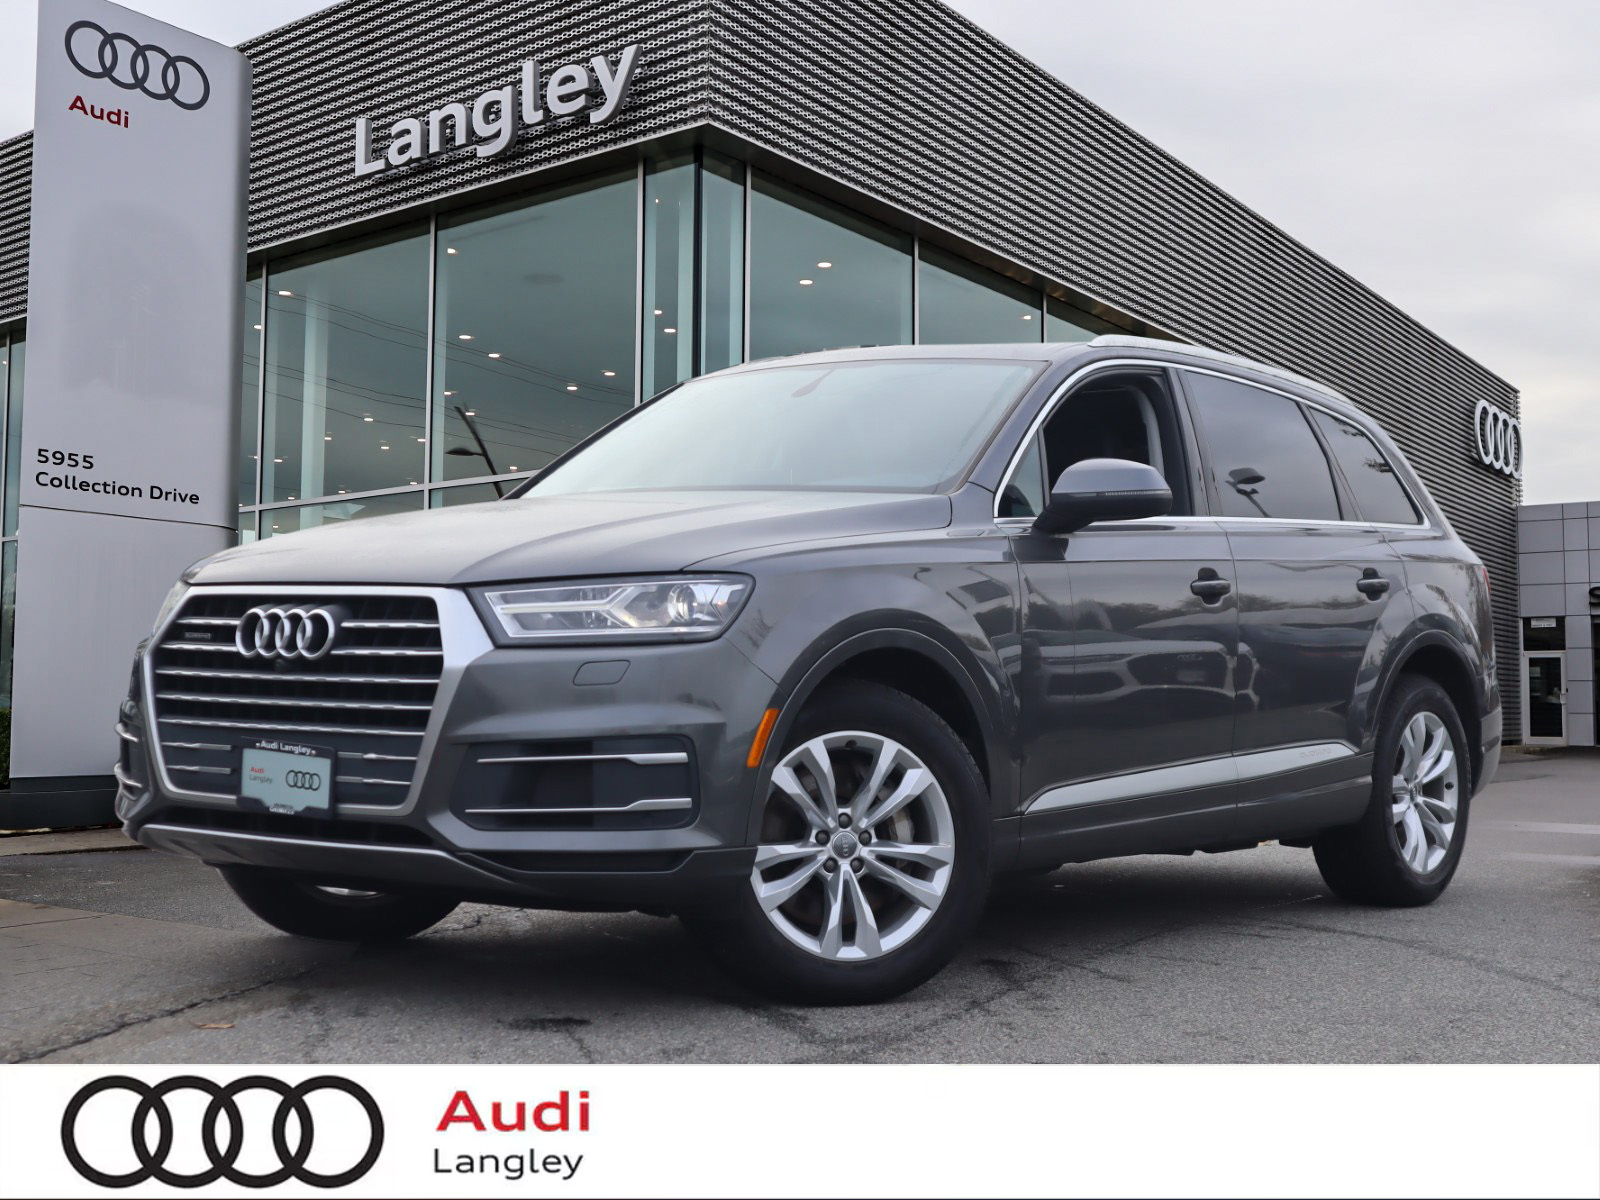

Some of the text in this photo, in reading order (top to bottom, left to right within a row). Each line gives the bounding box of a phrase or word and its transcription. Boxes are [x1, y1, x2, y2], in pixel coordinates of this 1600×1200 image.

[69, 95, 129, 128] Audi
[355, 44, 643, 176] Langley
[37, 448, 94, 470] 5955
[35, 471, 200, 505] Collection Drive
[260, 740, 311, 755] Audi Langley
[249, 774, 272, 784] Langley
[250, 766, 264, 774] Audi
